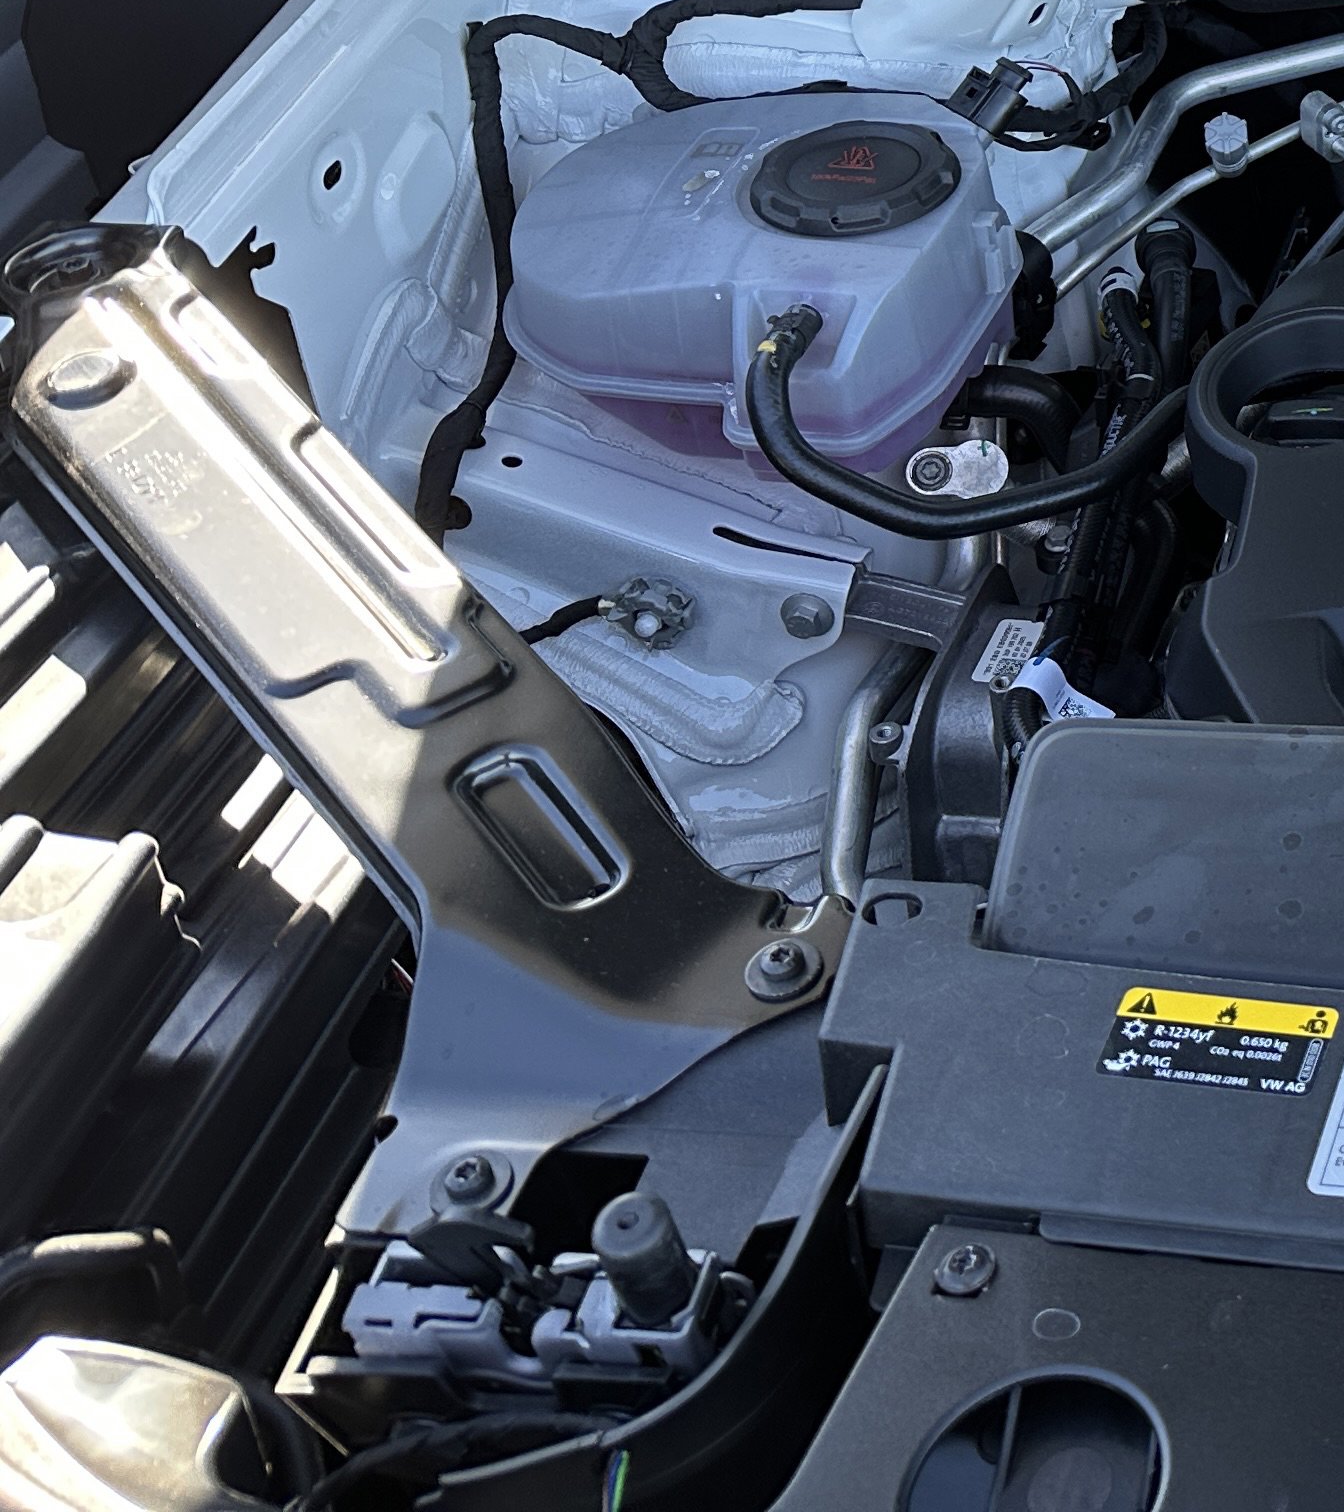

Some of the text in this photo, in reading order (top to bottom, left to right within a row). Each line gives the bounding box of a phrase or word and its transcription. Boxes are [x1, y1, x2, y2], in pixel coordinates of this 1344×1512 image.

[1154, 1024, 1216, 1044] R-1234yf
[1172, 1042, 1181, 1050] 4
[1239, 1035, 1289, 1052] 0.650 kg
[1141, 1054, 1172, 1068] PAG
[1260, 1078, 1306, 1093] VW AG
